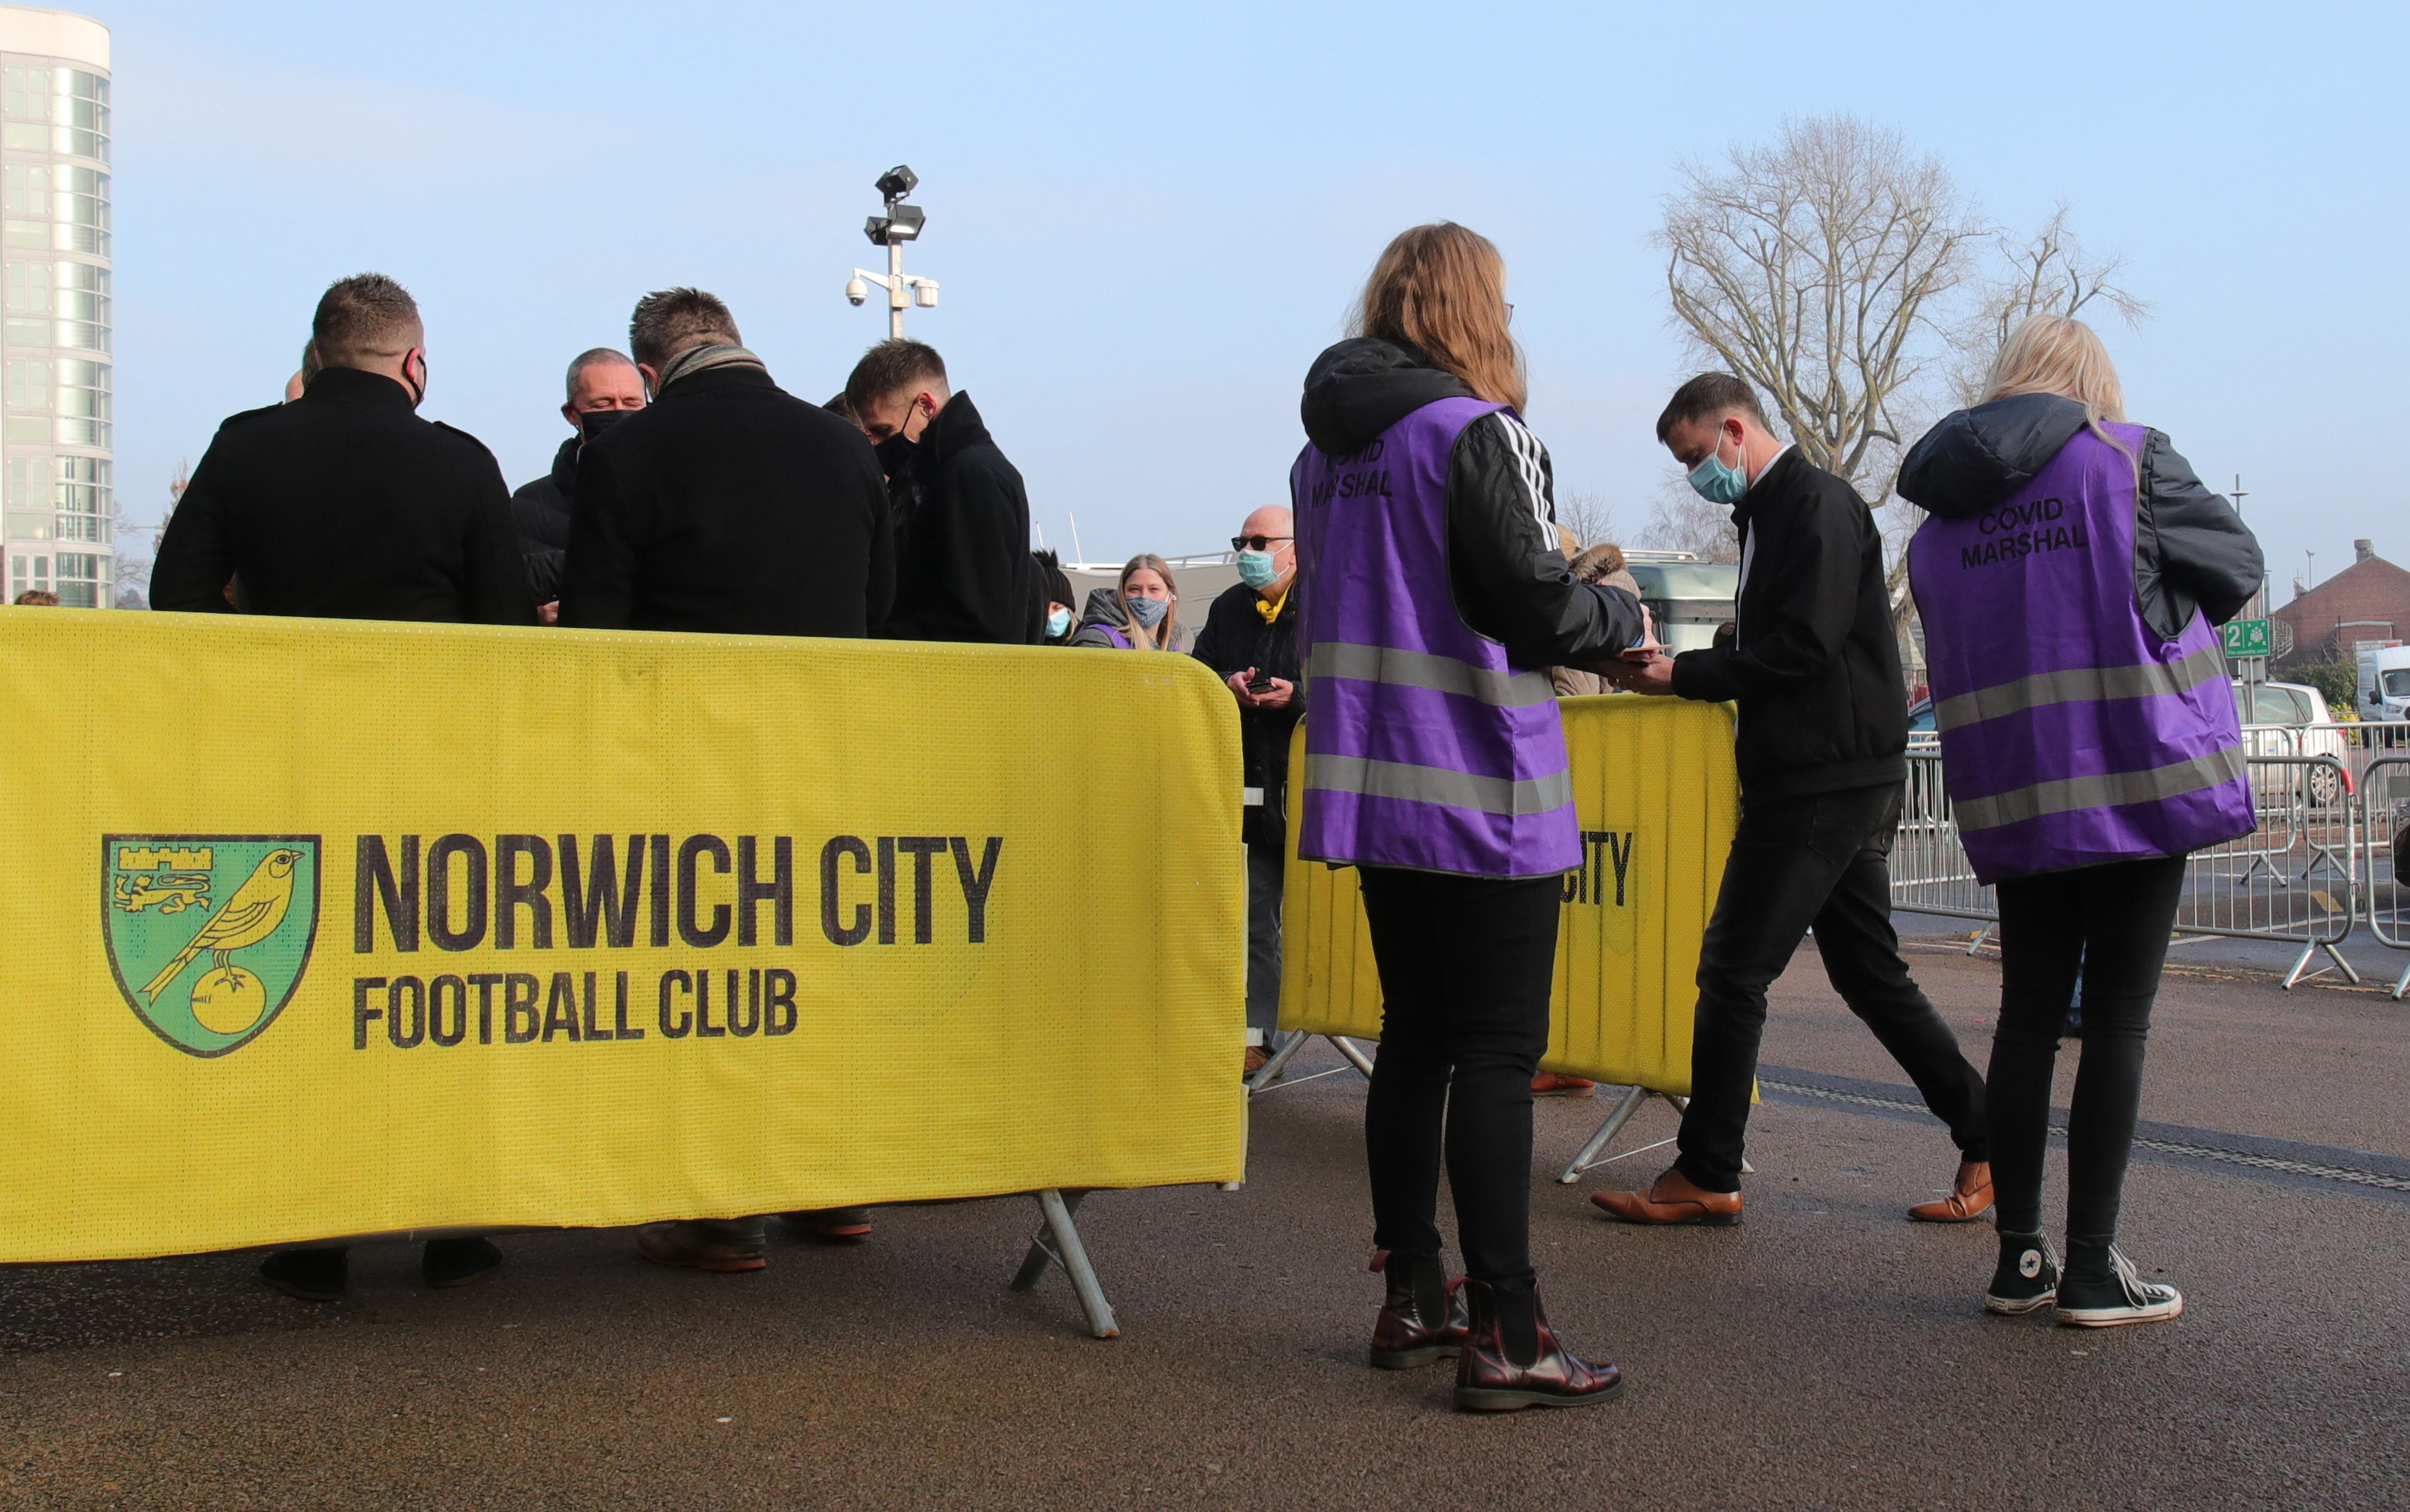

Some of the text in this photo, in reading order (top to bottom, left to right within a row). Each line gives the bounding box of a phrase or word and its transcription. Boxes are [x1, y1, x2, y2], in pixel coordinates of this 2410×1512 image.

[1978, 497, 2064, 535] COVID
[1960, 525, 2089, 570] MARSHAL
[2228, 624, 2241, 647] 2
[353, 833, 1004, 954] NORWICH CITY
[353, 968, 798, 1050] FOOTBALL CLUB
